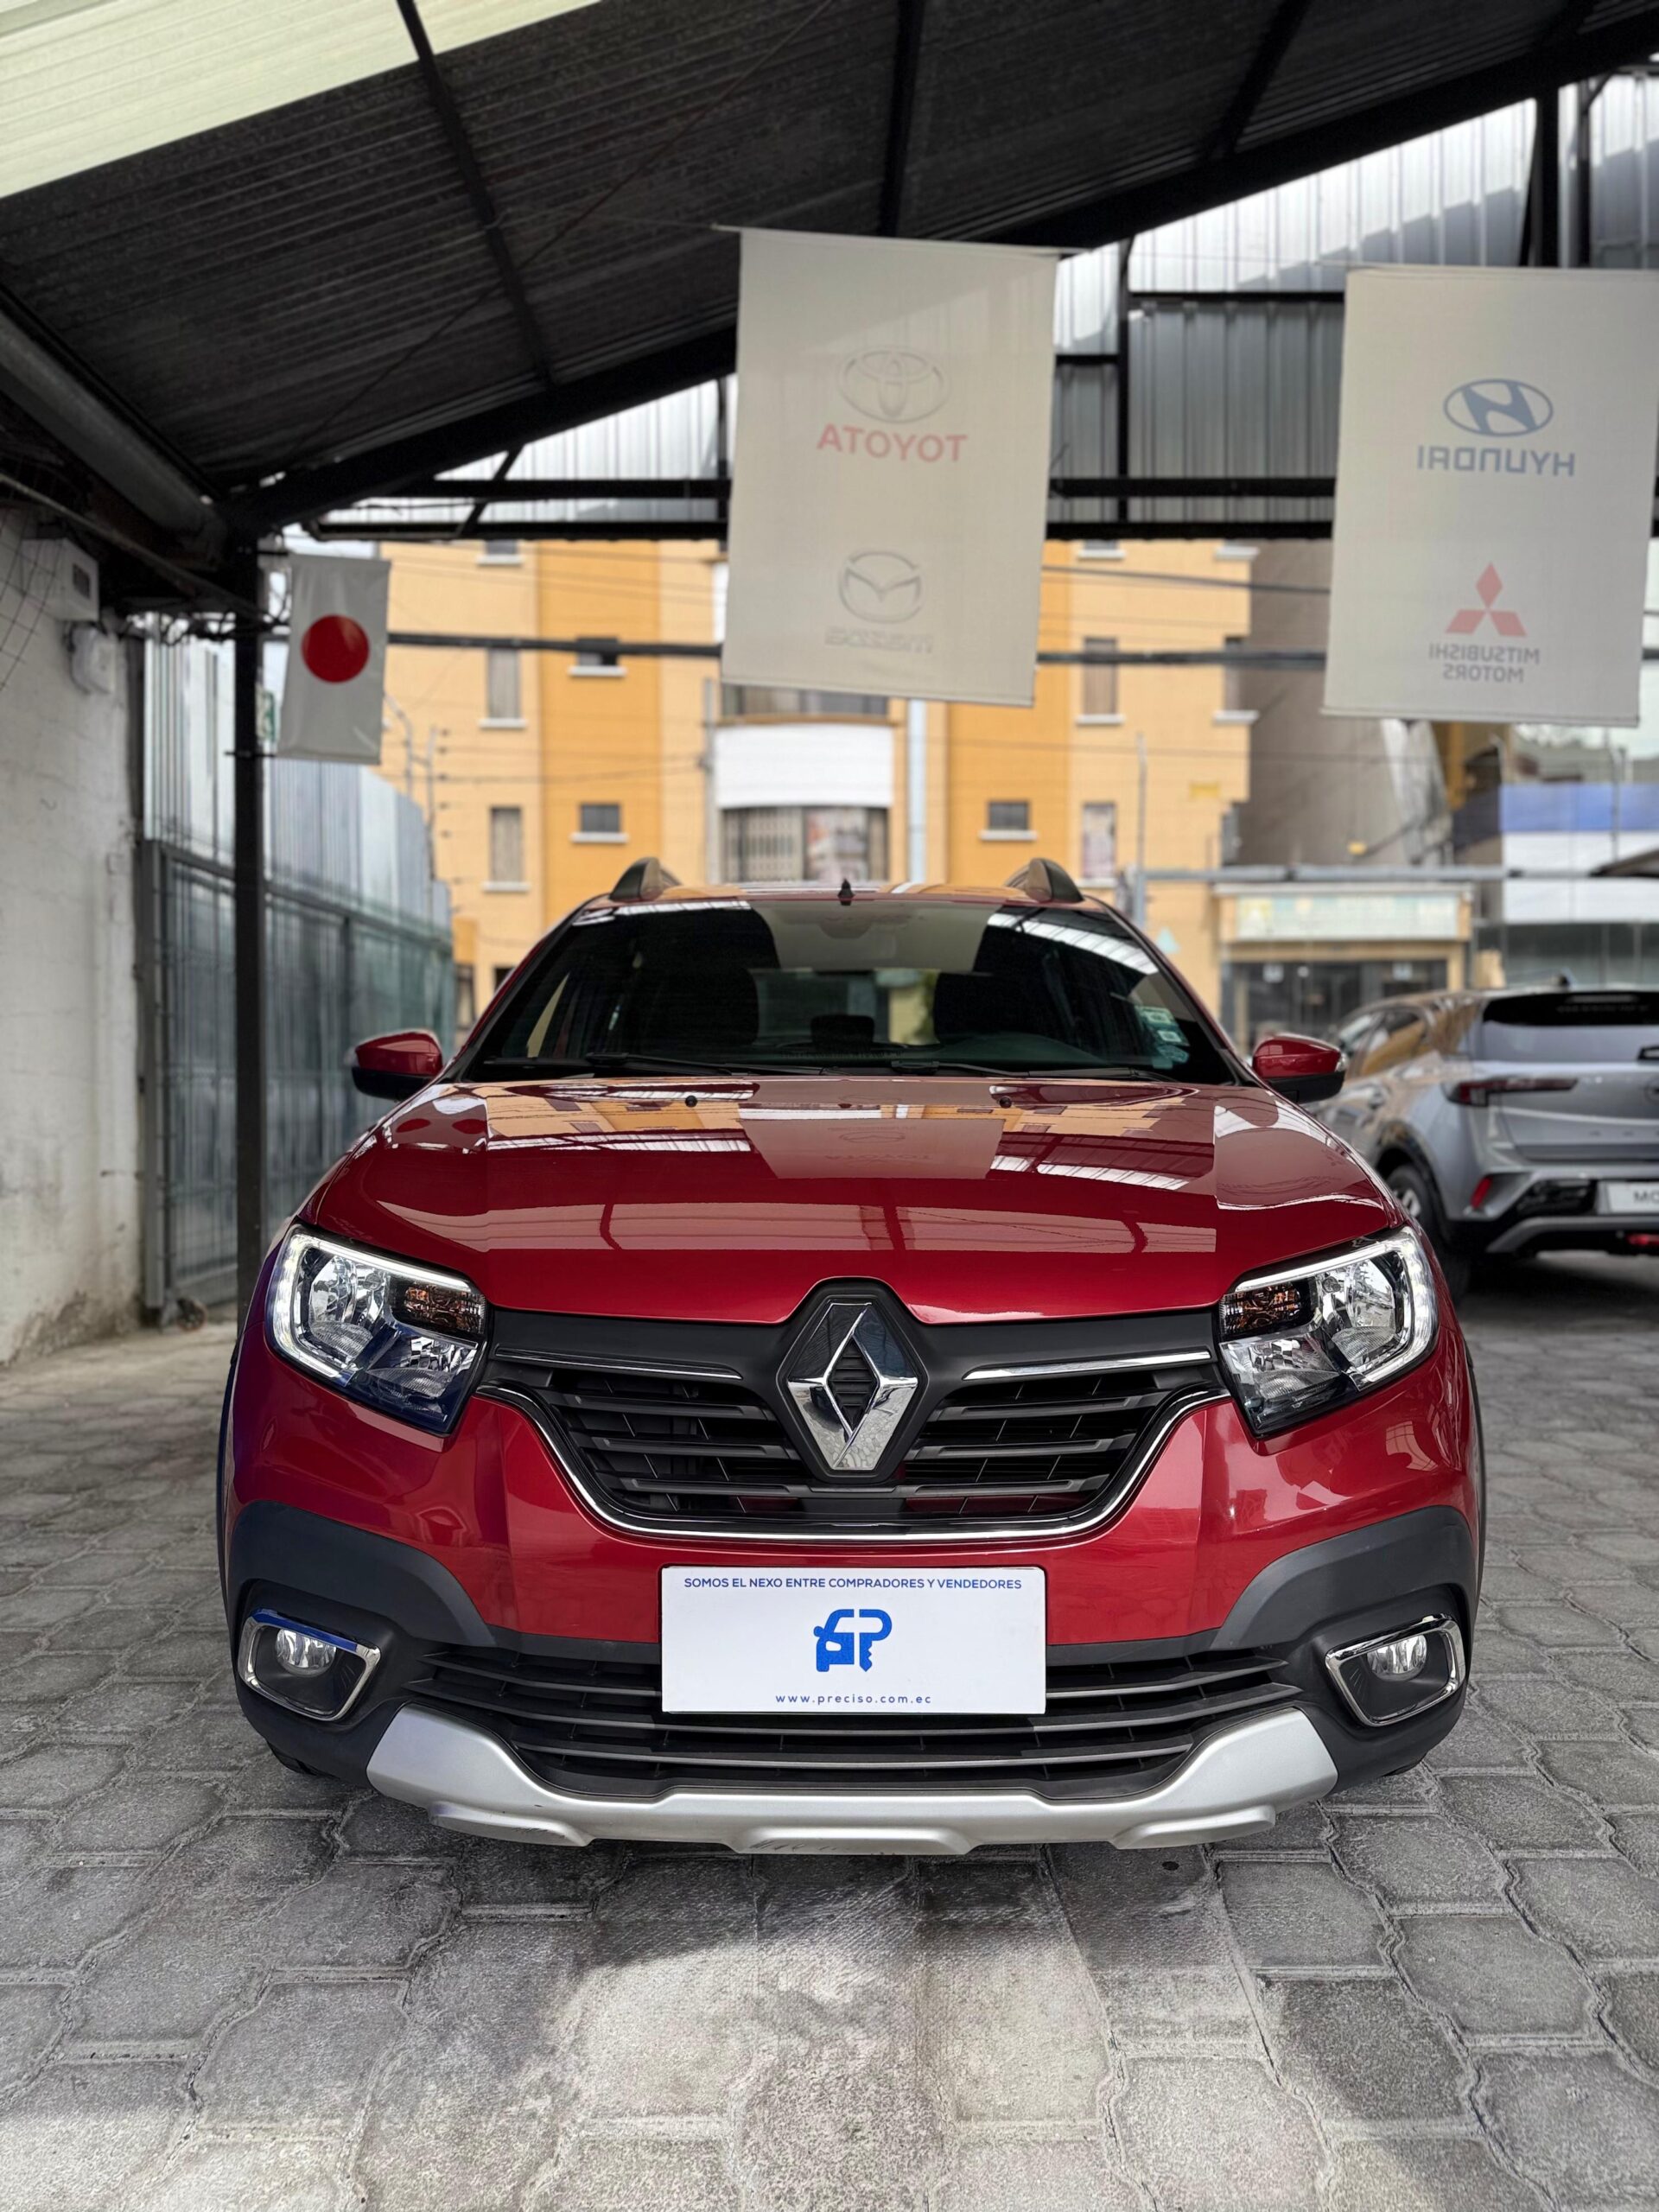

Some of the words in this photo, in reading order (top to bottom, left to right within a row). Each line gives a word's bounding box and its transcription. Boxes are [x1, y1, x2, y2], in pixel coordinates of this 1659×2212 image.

[683, 1578, 729, 1588] SOMOS
[732, 1578, 747, 1588] EL
[749, 1578, 782, 1588] NEXO
[785, 1578, 826, 1588] ENTRE
[829, 1578, 925, 1589] COMPRADORES
[927, 1579, 936, 1588] Y
[937, 1579, 1022, 1590] VENDEDORES
[776, 1694, 931, 1706] www.preciso.com.ec
